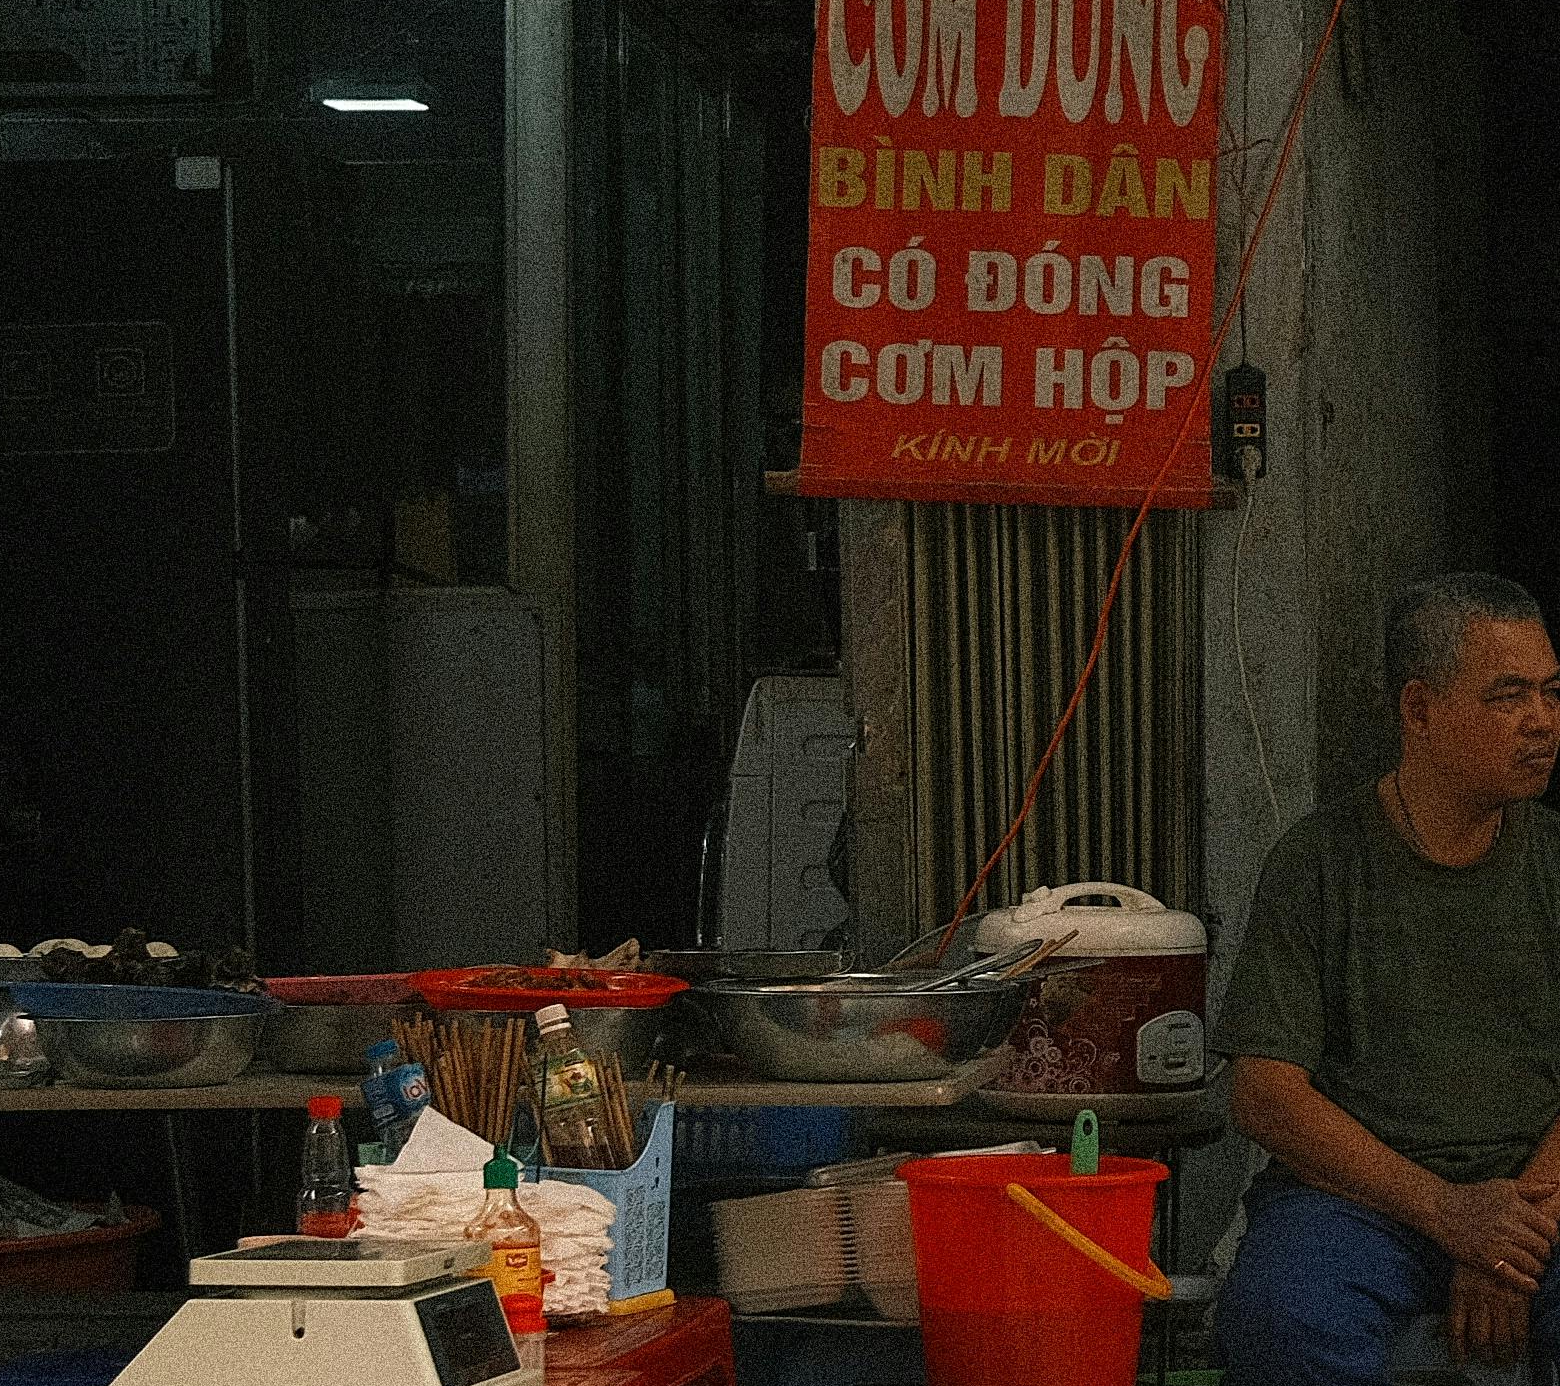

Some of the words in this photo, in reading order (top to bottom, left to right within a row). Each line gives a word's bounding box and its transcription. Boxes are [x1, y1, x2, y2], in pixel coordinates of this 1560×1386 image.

[817, 136, 1012, 211] BÌNH
[1043, 144, 1211, 219] DÂN
[832, 236, 936, 310] CÓ
[965, 240, 1189, 317] ĐÓNG
[821, 340, 1002, 405] CƠM
[1035, 337, 1195, 423] HỘP
[891, 430, 1011, 464] KÍNH
[1026, 433, 1120, 466] MỜI
